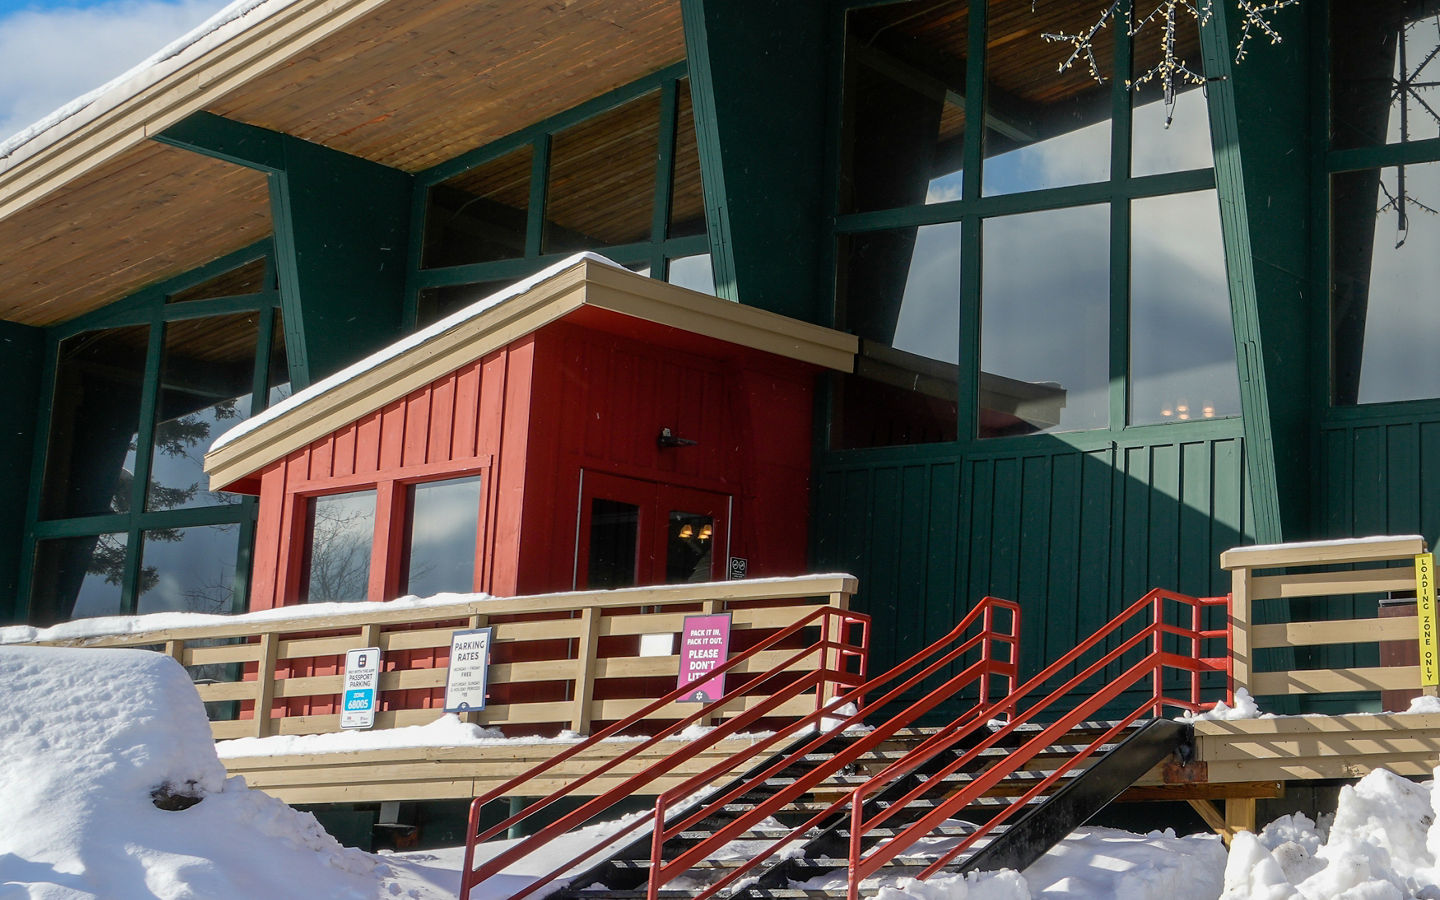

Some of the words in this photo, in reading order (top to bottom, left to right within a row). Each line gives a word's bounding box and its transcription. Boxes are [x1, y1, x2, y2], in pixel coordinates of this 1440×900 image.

[1421, 559, 1429, 610] LOADING
[690, 629, 705, 637] PACK
[1423, 616, 1431, 646] ZONE
[455, 641, 485, 651] PARKING
[457, 652, 479, 662] RATES
[688, 649, 719, 659] PLEASE
[689, 661, 716, 670] DON'T
[1425, 652, 1433, 681] ONLY
[349, 673, 373, 681] PASSPORT
